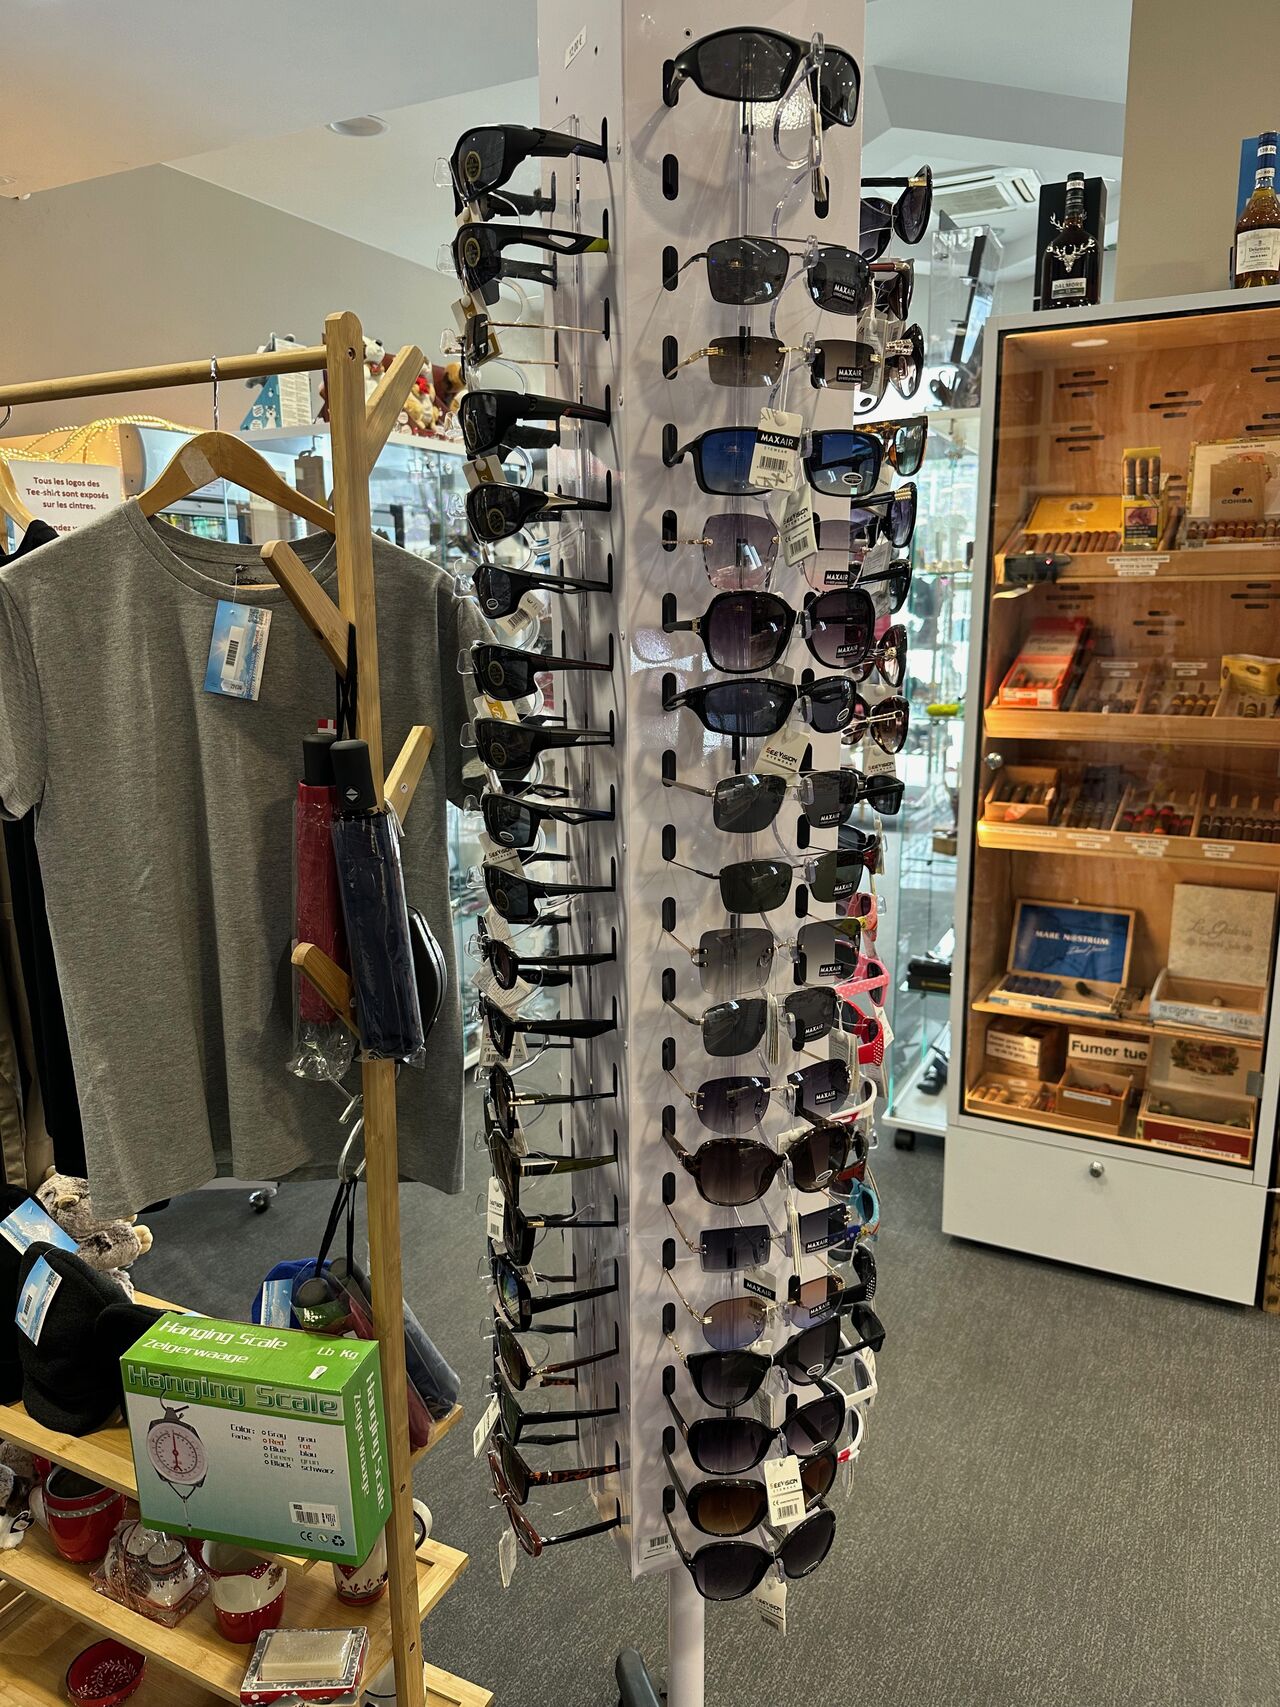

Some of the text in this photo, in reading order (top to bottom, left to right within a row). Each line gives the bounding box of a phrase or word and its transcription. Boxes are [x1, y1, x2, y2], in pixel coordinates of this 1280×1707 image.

[834, 284, 856, 296] MAXAIR
[1054, 281, 1084, 290] DALMORE
[838, 369, 862, 377] MAXAIR
[760, 434, 794, 447] MAXAIR
[33, 477, 100, 488] Tous les logos des
[26, 488, 60, 497] Tee-shirt
[80, 492, 109, 500] exposés
[43, 501, 96, 510] sur les cintres.
[826, 573, 849, 581] MAXAIR
[838, 645, 858, 653] MAXAIR
[821, 812, 840, 821] MAXAIR
[834, 882, 853, 891] MAXAIR
[1035, 930, 1110, 945] MARE NOSTRUM
[820, 965, 842, 973] MAXAIR
[804, 1023, 824, 1034] MAXAIR
[1072, 1040, 1148, 1061] Fumer tue
[815, 1090, 836, 1100] MAXAIR
[807, 1238, 829, 1249] MAXAIR
[746, 1281, 772, 1298] MAXAIR
[810, 1301, 831, 1314] MAXAIR
[158, 1320, 288, 1351] Hanging Scale
[317, 1347, 359, 1360] Lb Kg
[128, 1364, 338, 1417] Hanging Scale
[267, 1430, 287, 1440] Gray
[366, 1371, 386, 1513] Hanging Scale
[299, 1450, 317, 1458] blau
[270, 1460, 335, 1474] Black schwarz
